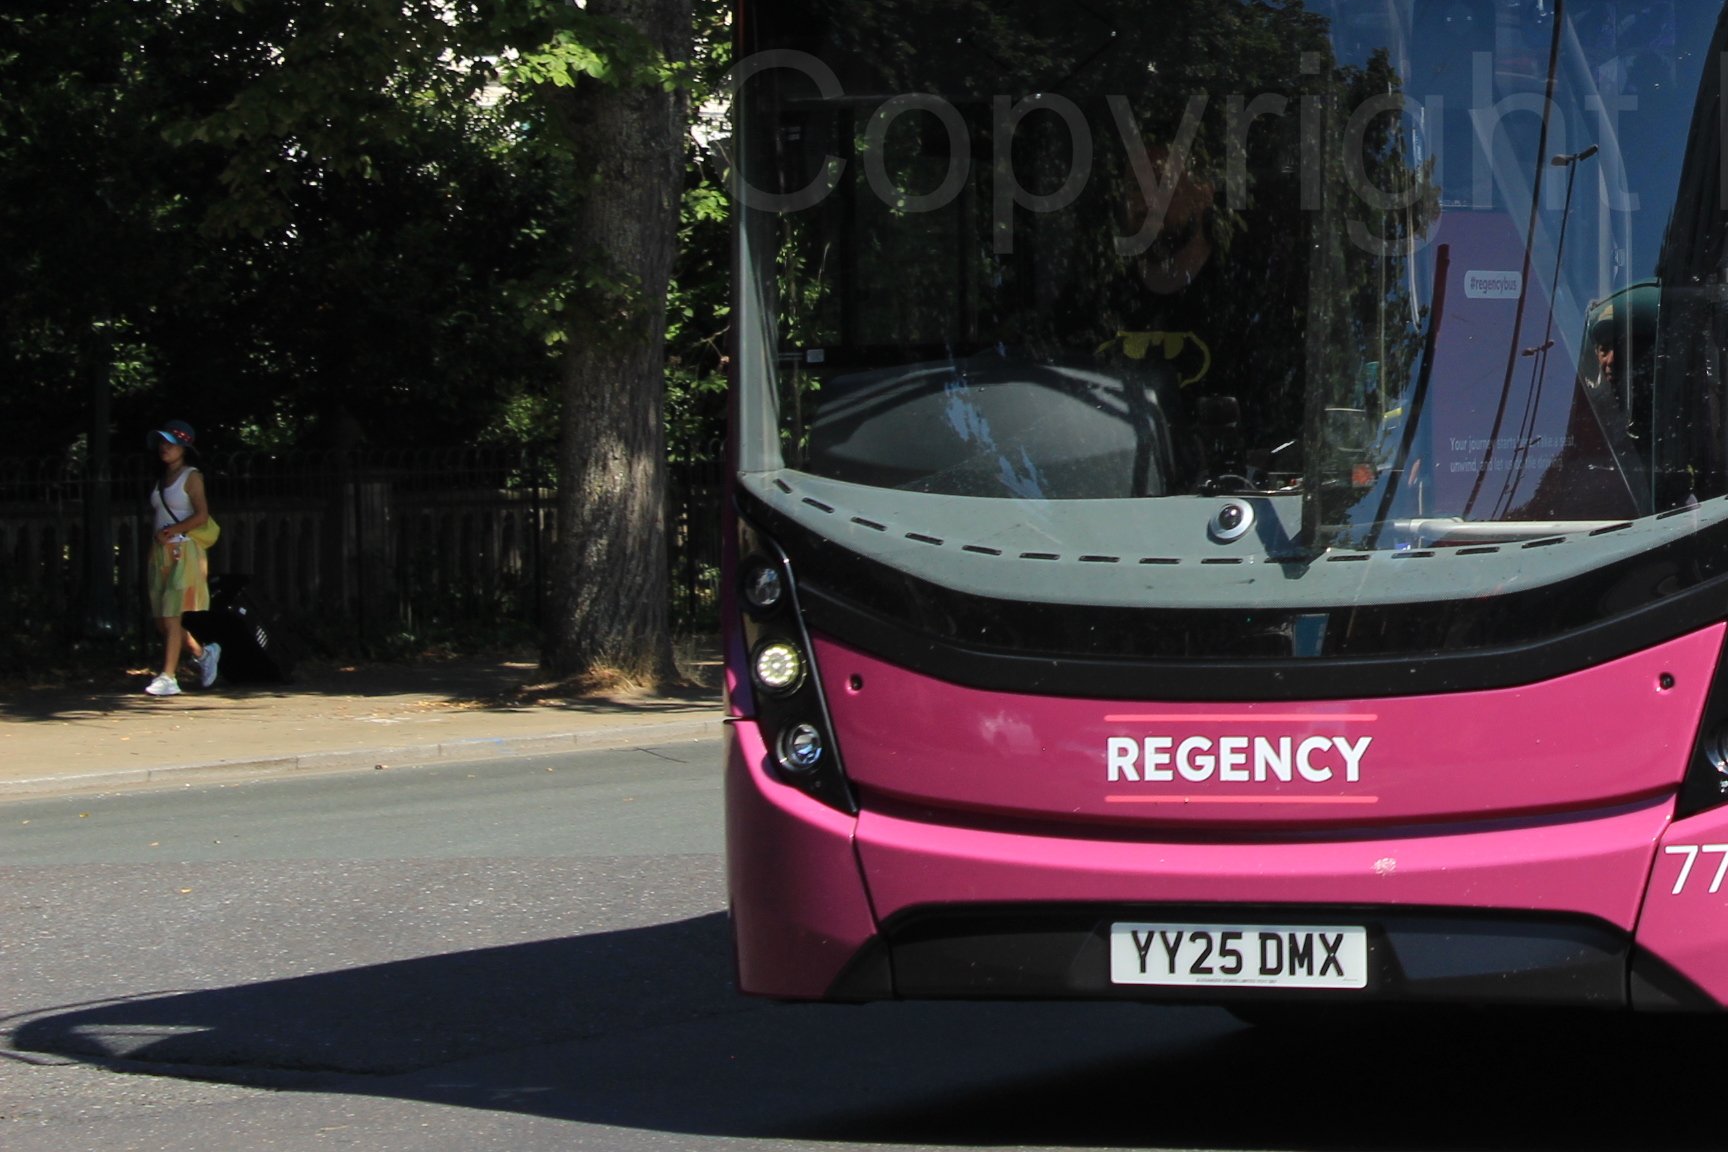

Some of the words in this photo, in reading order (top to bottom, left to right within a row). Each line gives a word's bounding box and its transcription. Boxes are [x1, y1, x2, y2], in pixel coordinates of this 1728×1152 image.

[1470, 276, 1517, 294] #regencybus
[1107, 736, 1372, 782] REGENCY
[1130, 929, 1243, 976] YY25
[1258, 931, 1345, 978] DMX
